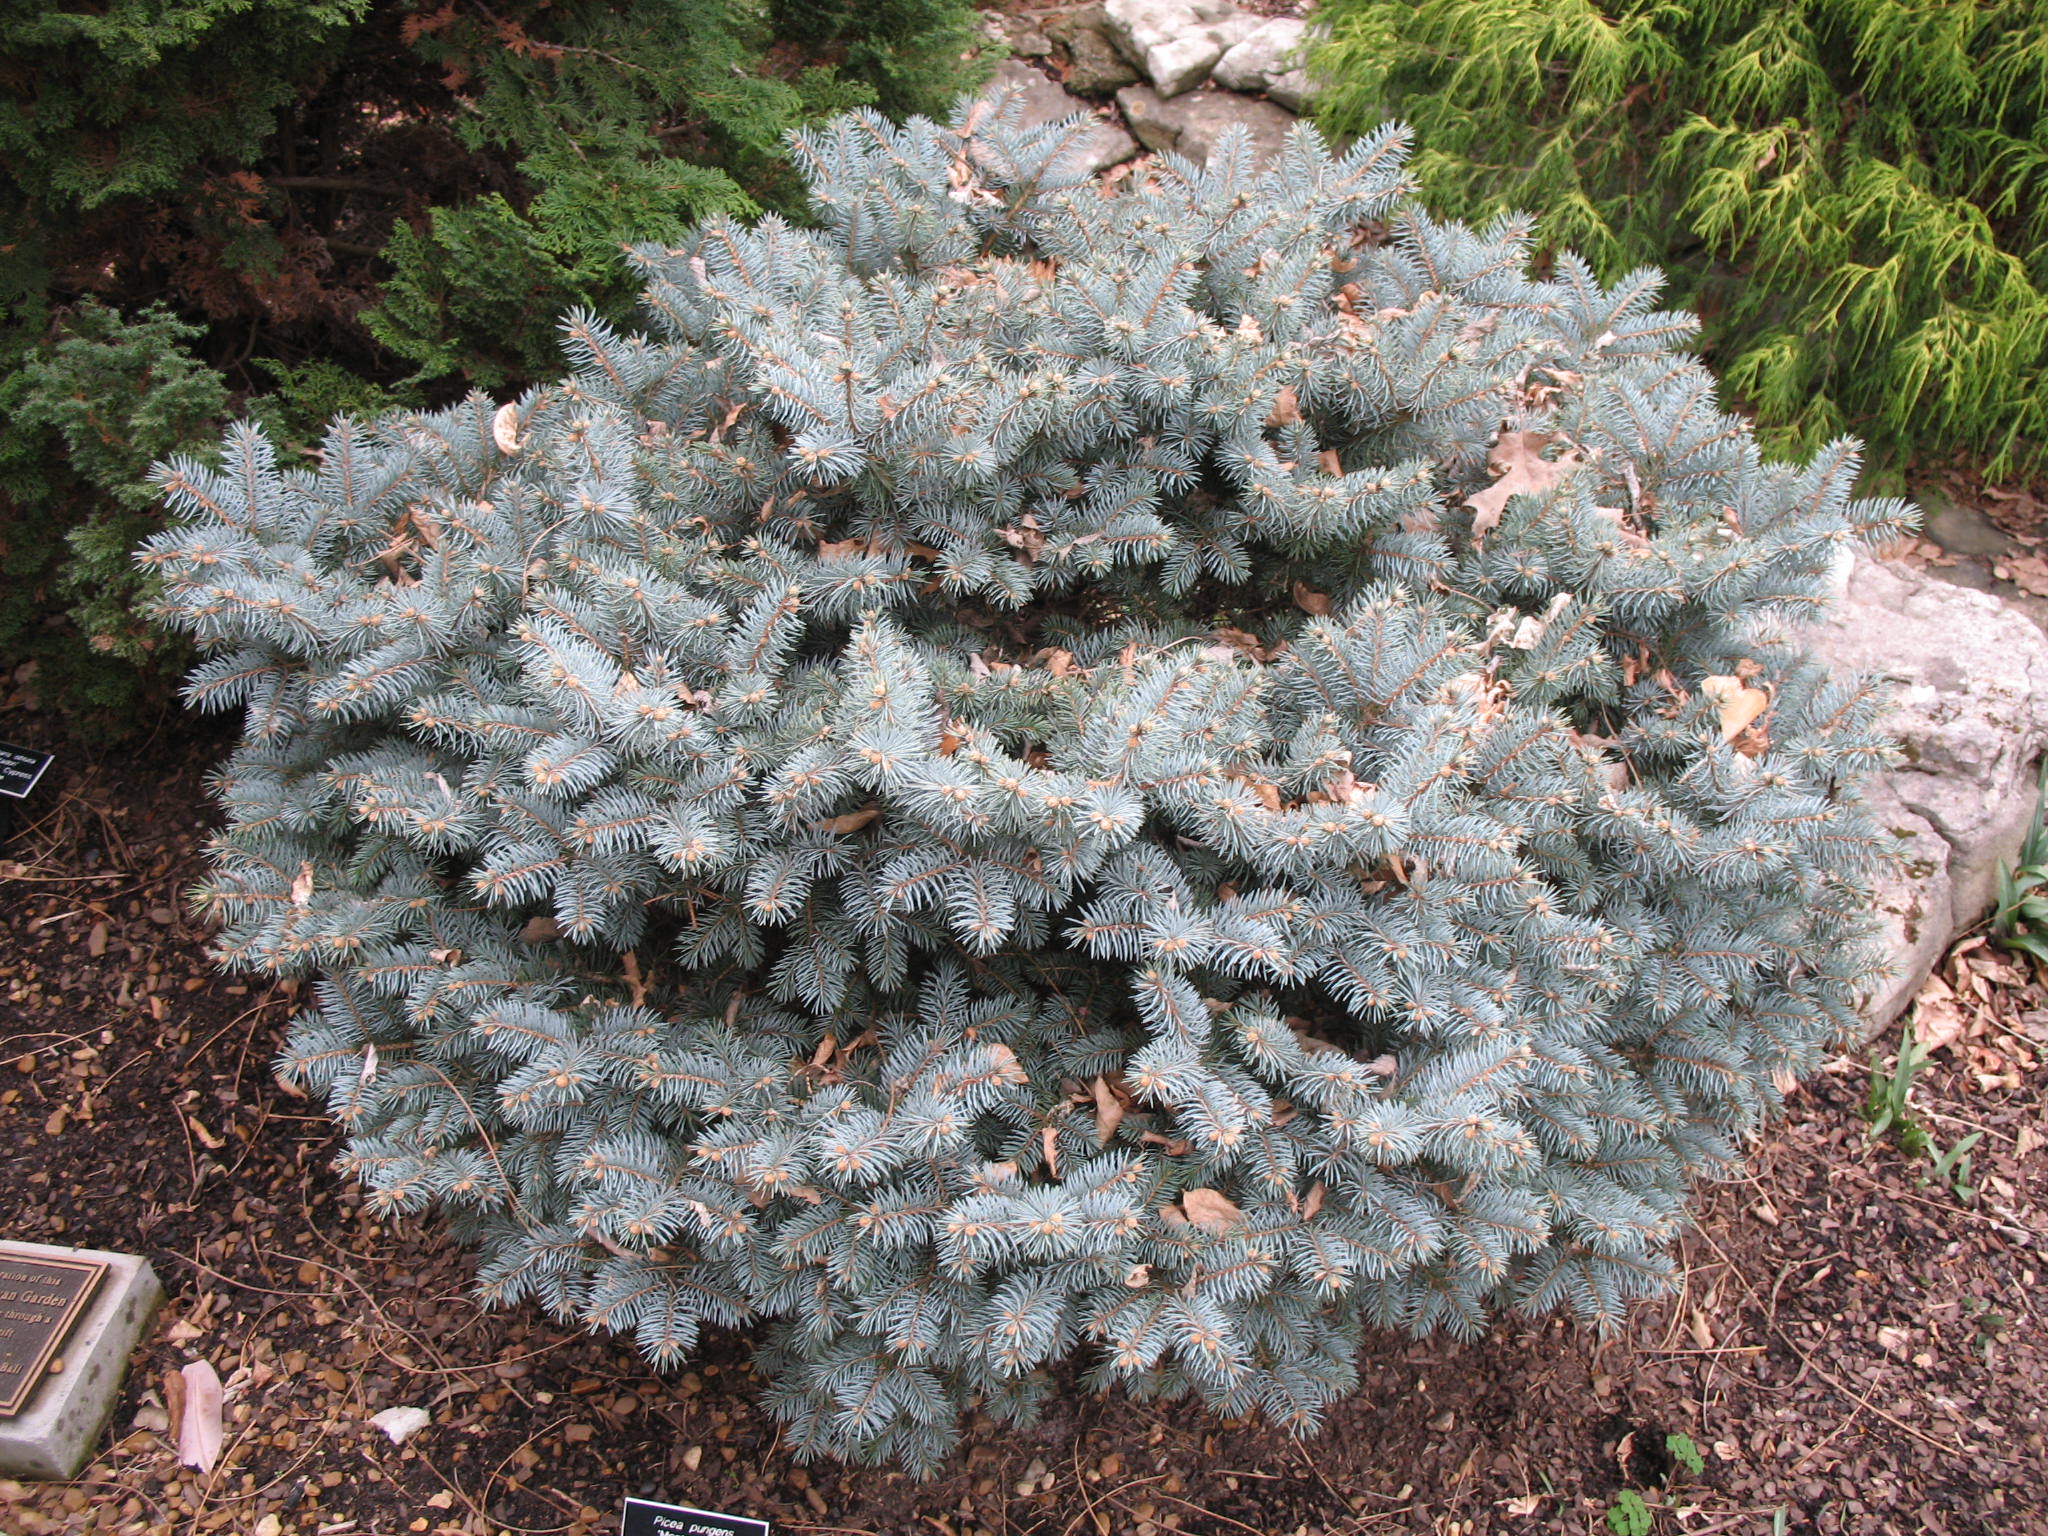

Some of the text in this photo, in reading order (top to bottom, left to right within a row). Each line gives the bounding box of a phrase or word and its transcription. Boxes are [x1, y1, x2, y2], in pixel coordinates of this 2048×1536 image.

[21, 1291, 67, 1306] Garden
[6, 1312, 42, 1323] through
[653, 1516, 684, 1529] Picea
[689, 1524, 735, 1536] pungens
